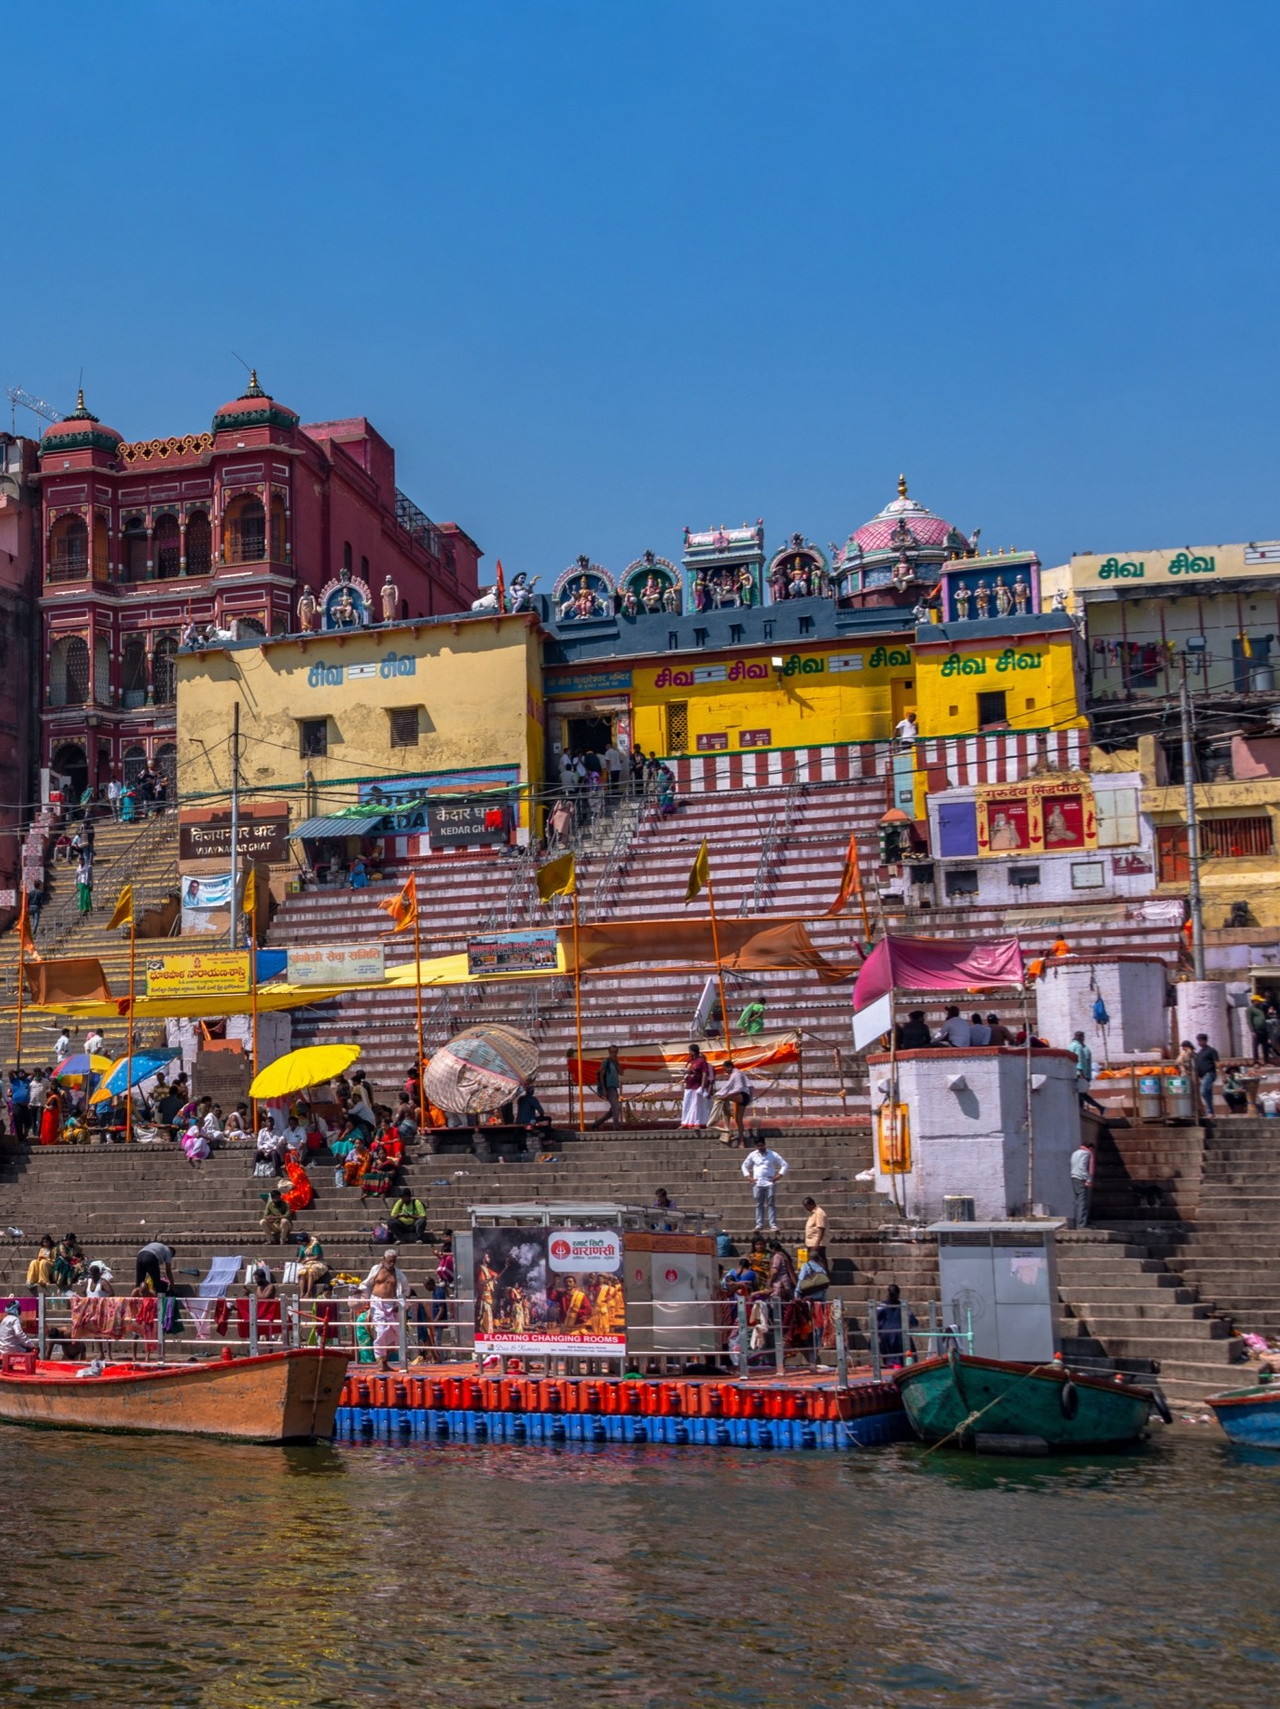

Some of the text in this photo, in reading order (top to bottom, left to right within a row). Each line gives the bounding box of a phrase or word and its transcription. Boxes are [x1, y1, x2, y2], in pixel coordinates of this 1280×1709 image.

[1098, 552, 1215, 580] சிவ சிவ
[308, 651, 416, 688] சிவ சிவ
[783, 646, 912, 677] சிவ சிவ
[941, 648, 1042, 677] சிவ சிவ
[654, 660, 768, 689] சிவ சிவ
[435, 805, 471, 822] केदार
[190, 825, 277, 843] विजयनर घाट
[440, 824, 470, 836] KEDAR
[196, 842, 271, 856] VIJAYNAAR GHAT
[572, 1244, 615, 1256] वाराणसी
[483, 1334, 619, 1343] FLOATING CHANGING ROOMS
